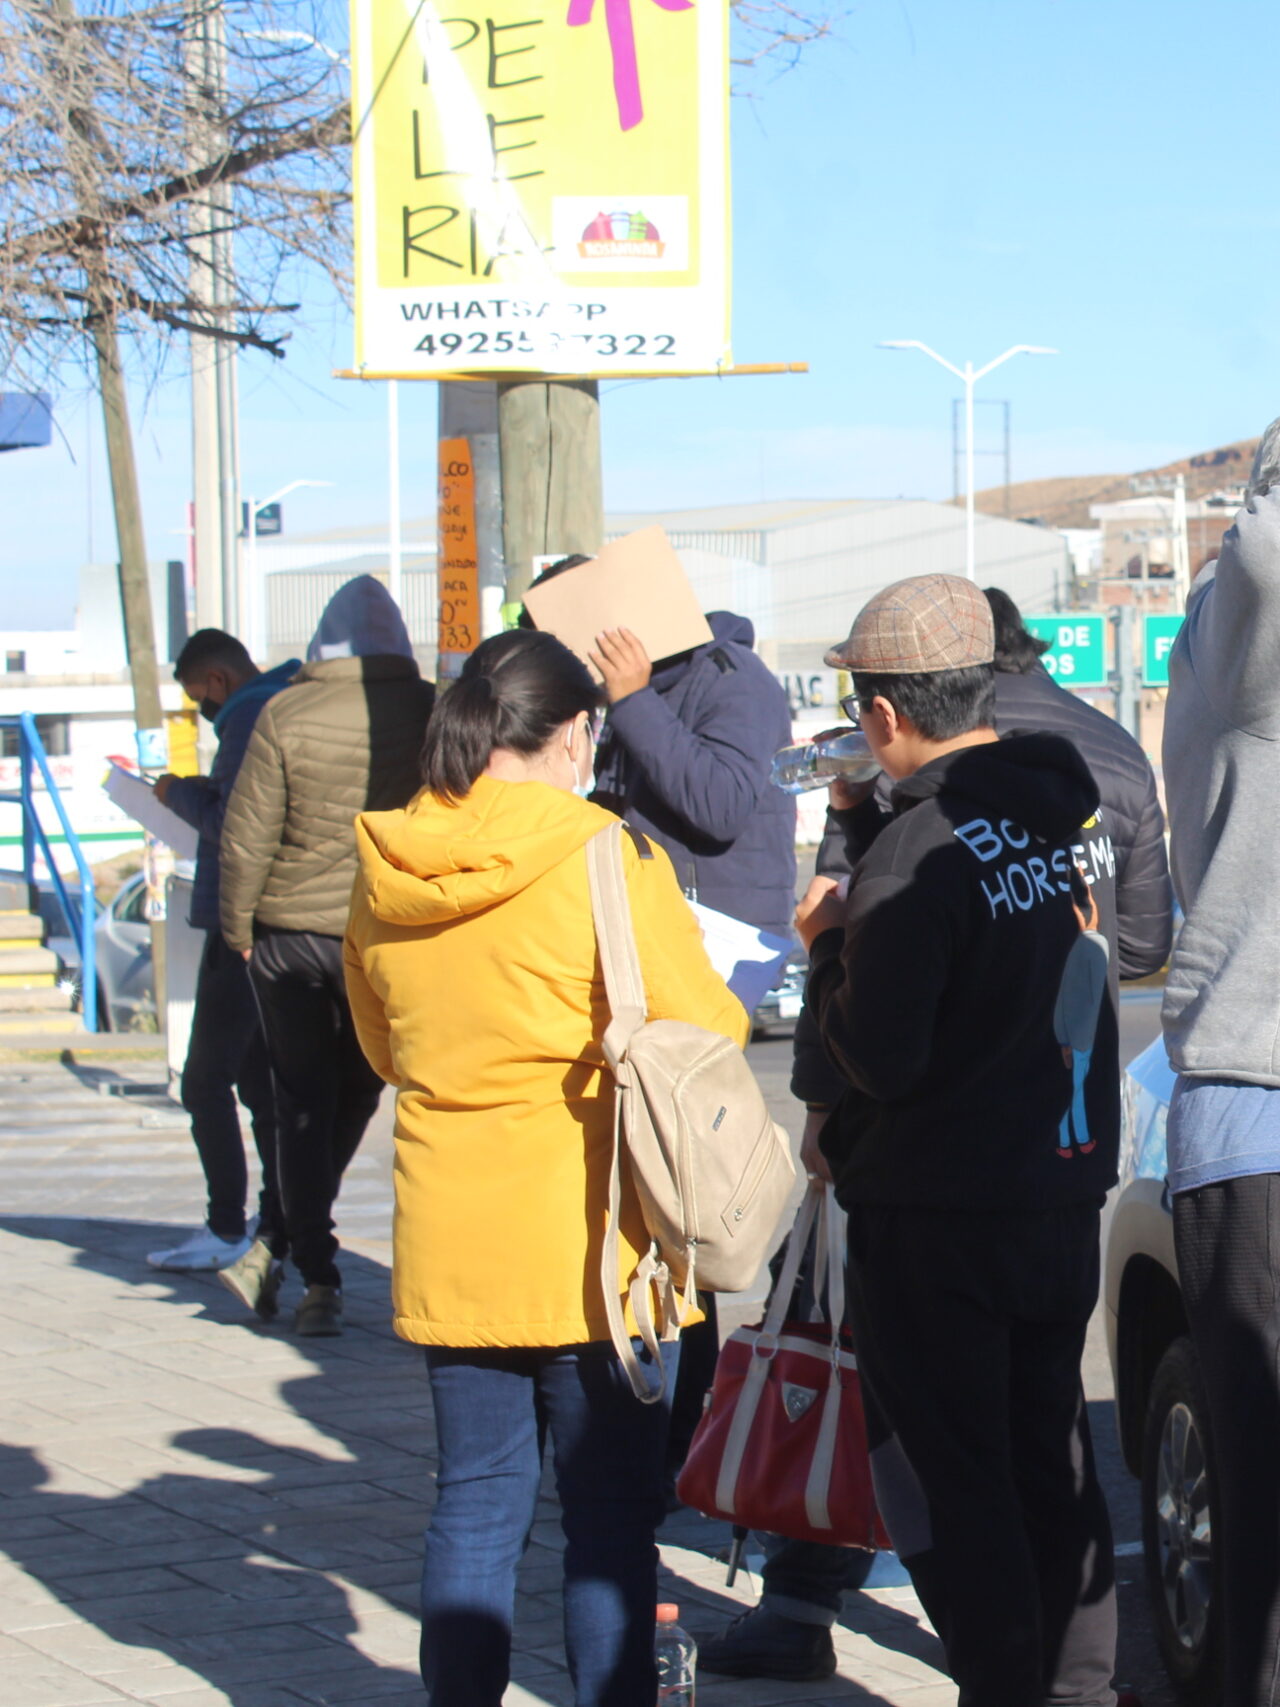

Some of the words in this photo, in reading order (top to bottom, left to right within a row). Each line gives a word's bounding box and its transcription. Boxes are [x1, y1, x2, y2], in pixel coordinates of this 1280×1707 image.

[421, 17, 545, 89] PE
[412, 109, 545, 182] LE
[402, 204, 557, 279] RIA
[1057, 626, 1091, 648] DE
[1154, 636, 1175, 661] F
[953, 818, 1047, 862] BO
